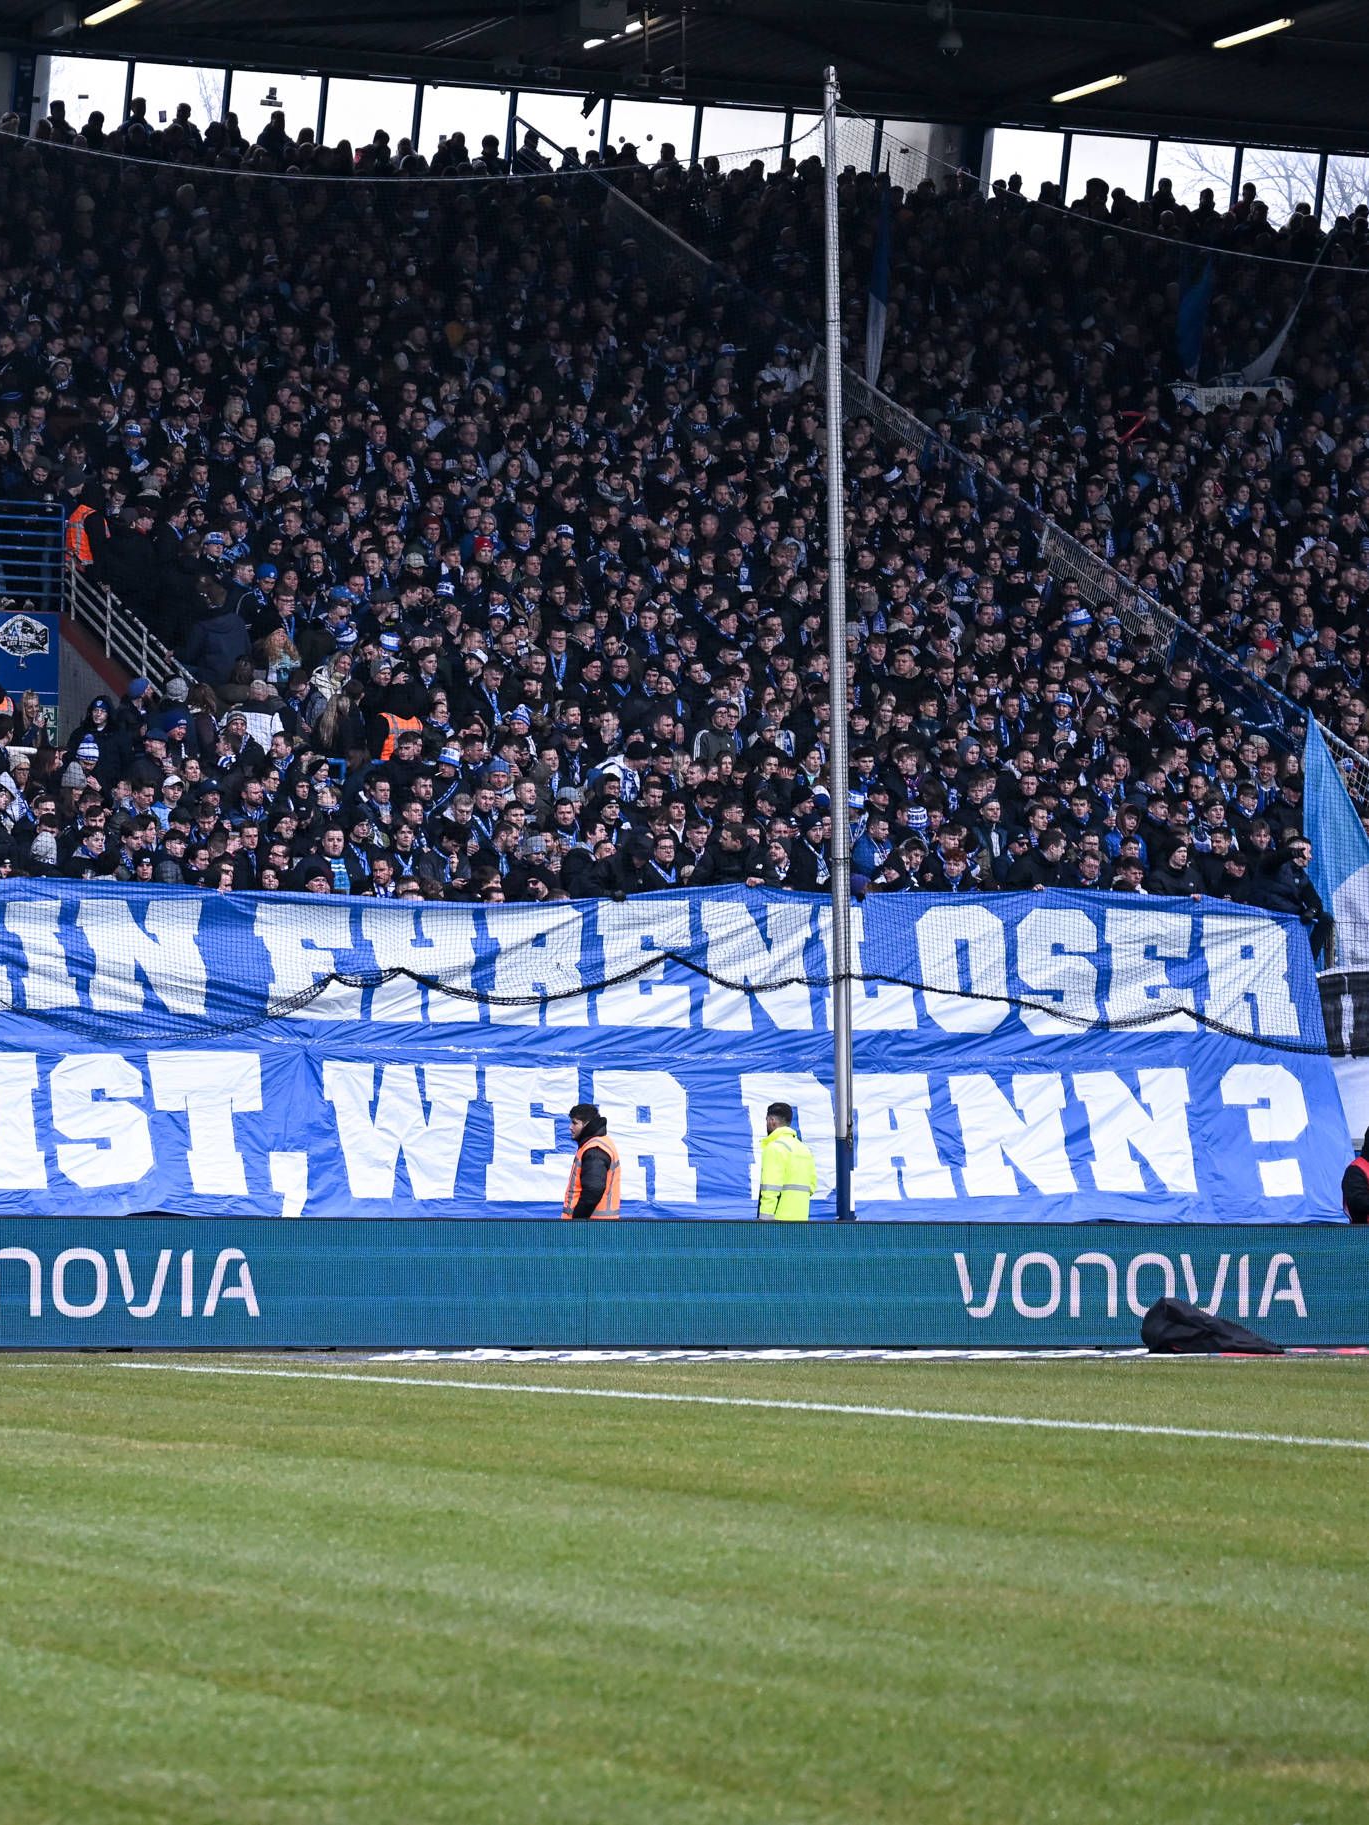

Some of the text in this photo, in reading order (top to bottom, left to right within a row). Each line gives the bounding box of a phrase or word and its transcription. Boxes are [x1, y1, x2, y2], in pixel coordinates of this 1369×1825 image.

[253, 899, 1301, 1038] EHRENLOSER
[322, 1060, 697, 1202] WER
[953, 1251, 1308, 1320] VONOVIA
